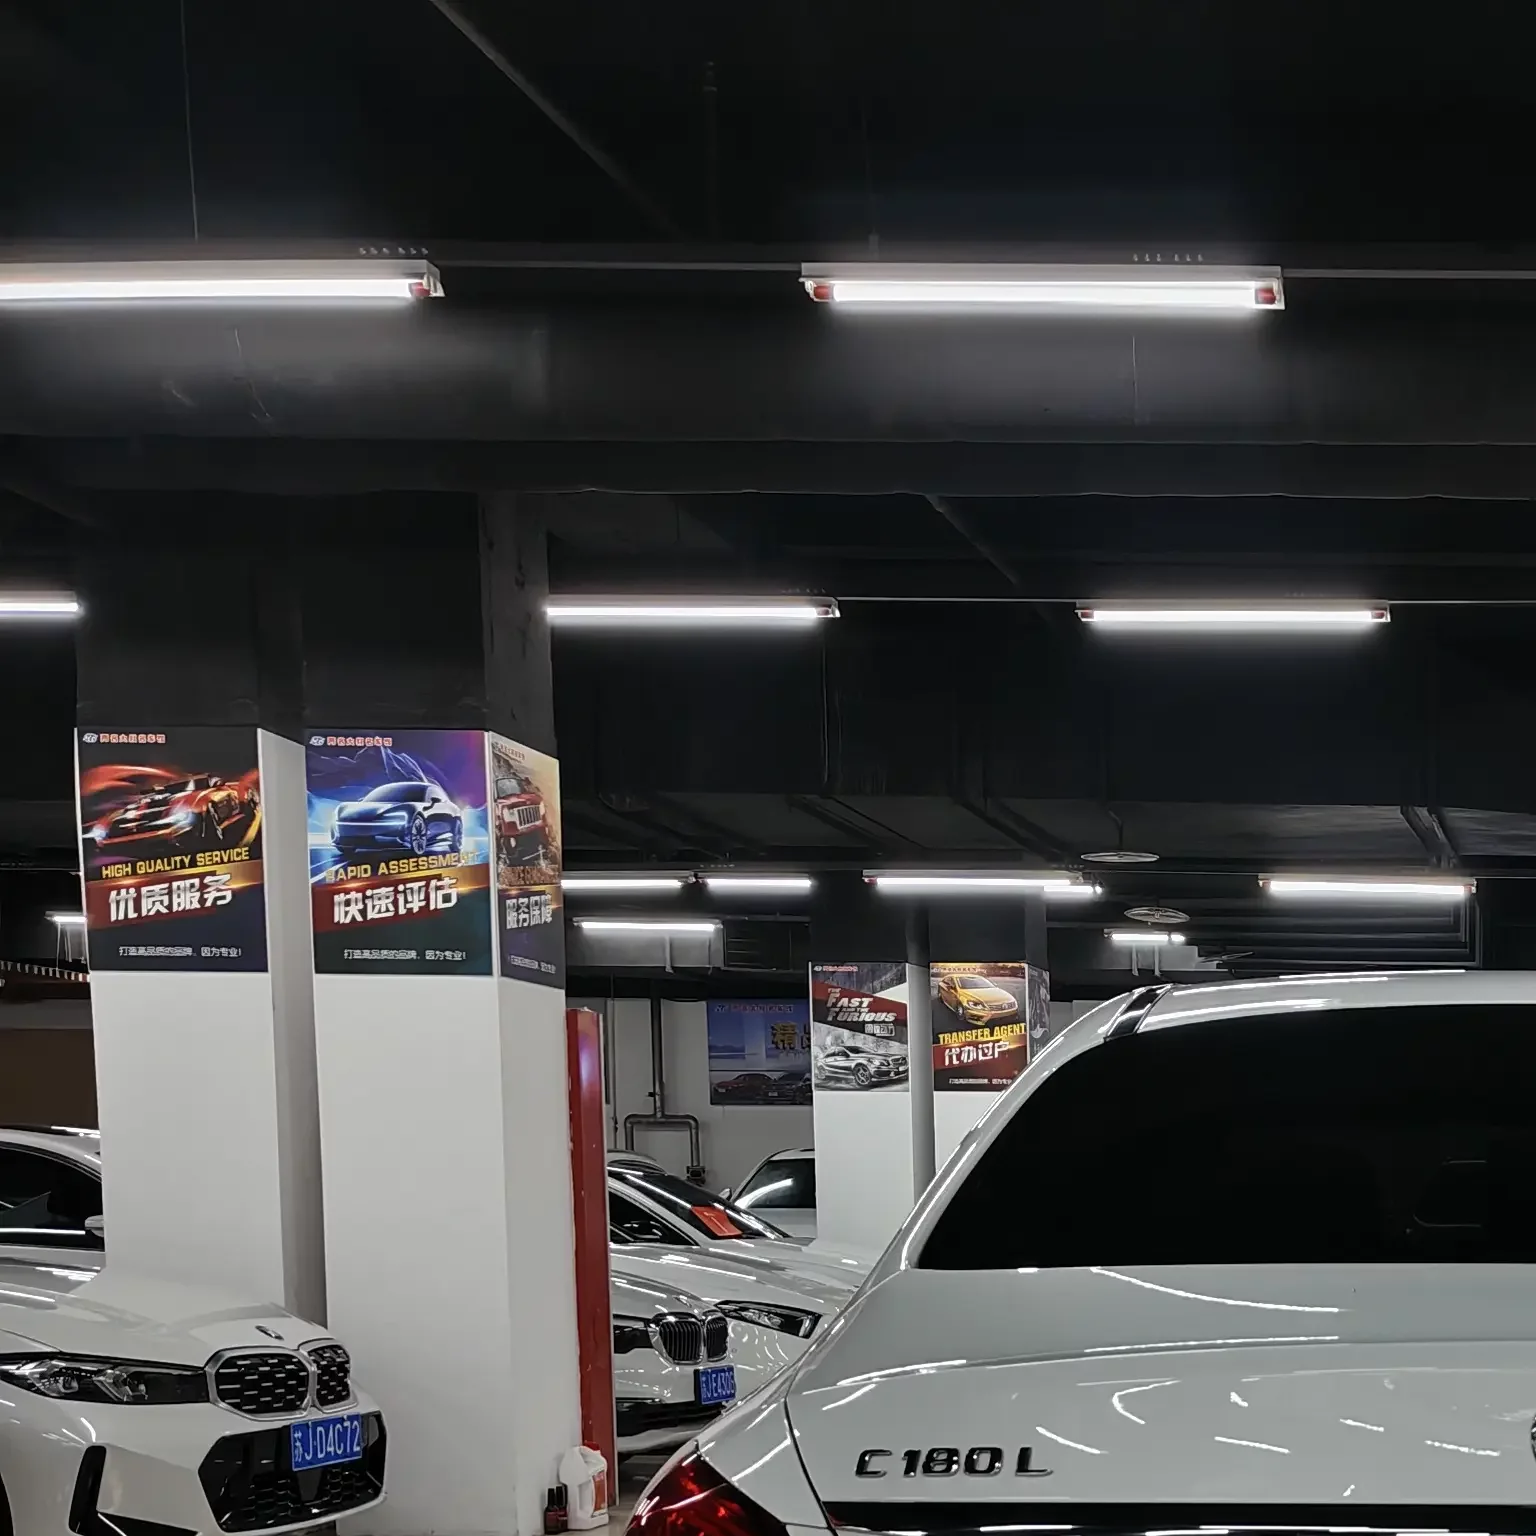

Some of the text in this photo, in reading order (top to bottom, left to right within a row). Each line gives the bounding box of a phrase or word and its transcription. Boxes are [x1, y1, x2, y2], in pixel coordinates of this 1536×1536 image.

[101, 846, 250, 879] HIGH QUALITY SERVICE
[325, 864, 372, 883] RAPID
[108, 873, 233, 922] 优质服务
[333, 876, 459, 924] 快速评估
[827, 993, 874, 1008] FAST
[827, 1008, 897, 1022] FURIOUS
[938, 1022, 1026, 1045] TRANSFER AGENT
[944, 1041, 1010, 1066] 代办过户
